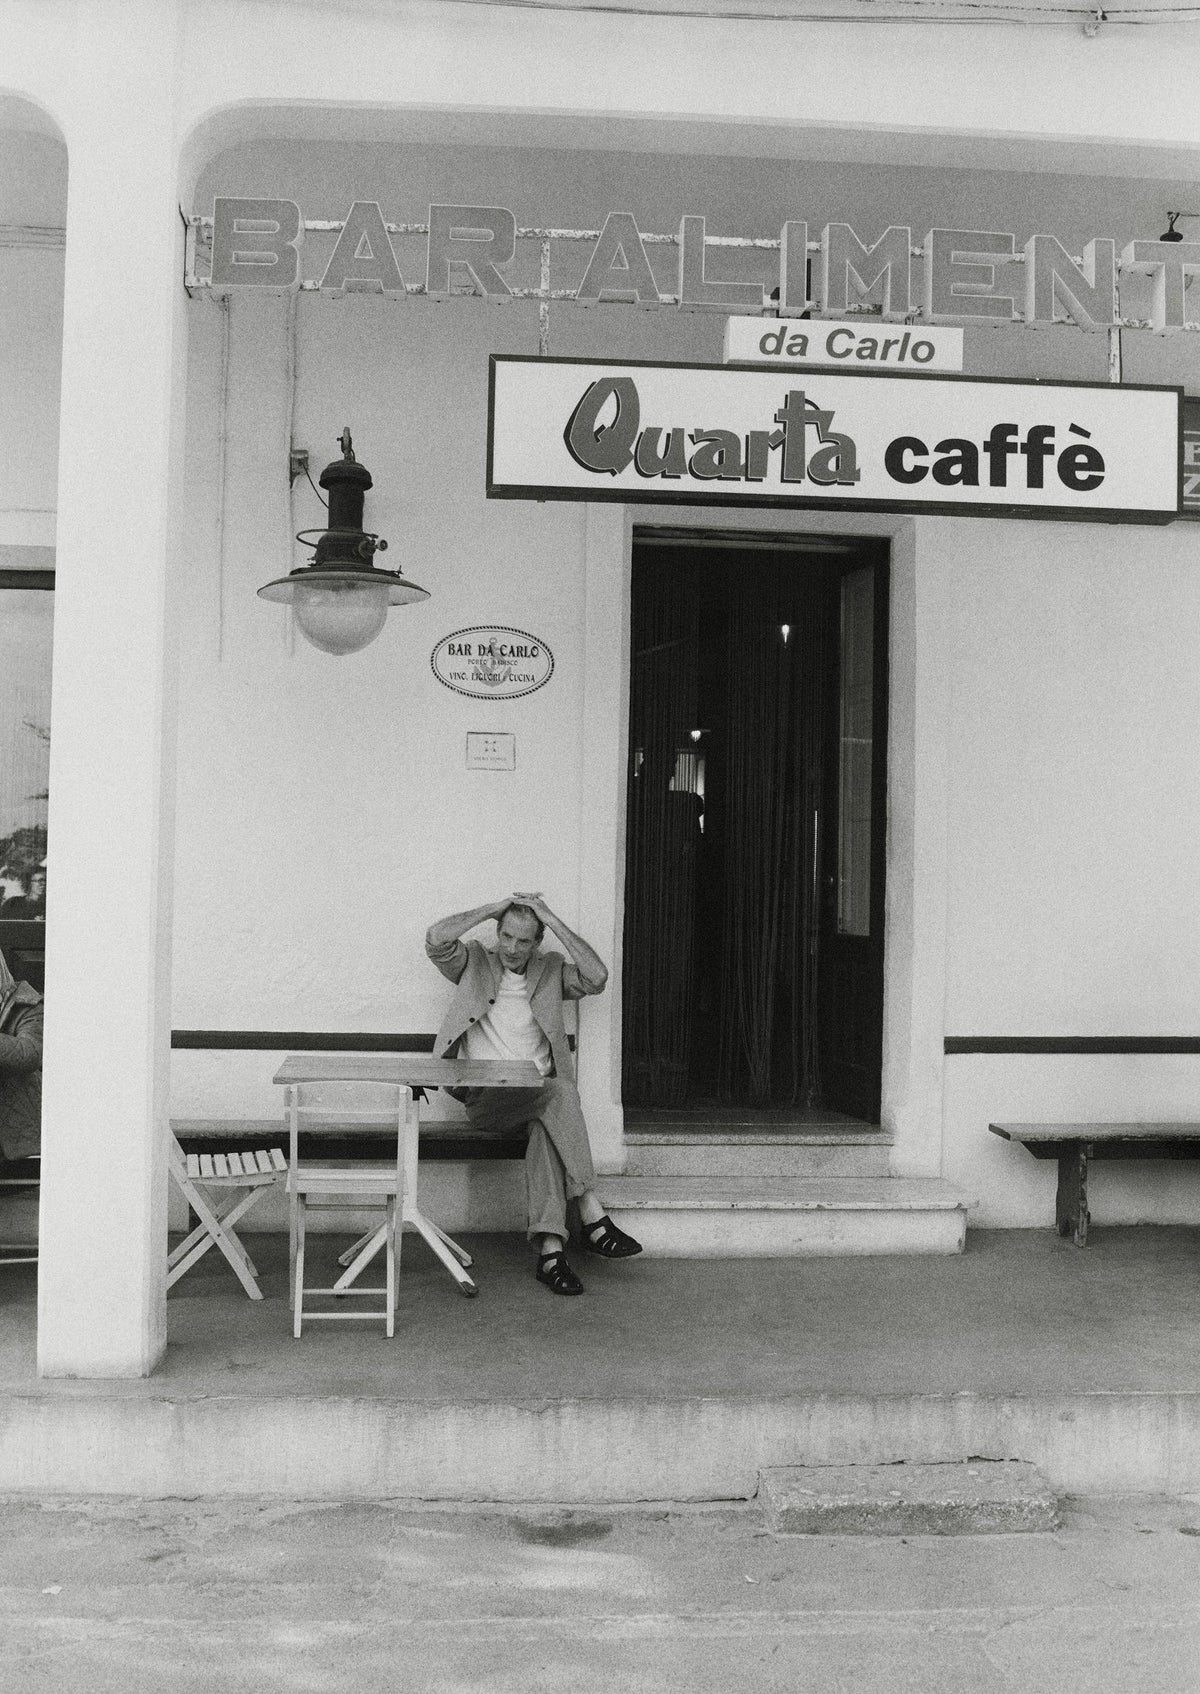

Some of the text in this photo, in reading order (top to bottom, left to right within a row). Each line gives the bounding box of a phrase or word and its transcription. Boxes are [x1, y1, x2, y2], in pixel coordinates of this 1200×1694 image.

[211, 196, 513, 297] BAR
[759, 326, 935, 363] da Carlo
[563, 377, 1105, 491] Quarta caffè
[448, 643, 539, 658] BAR DA CARLO
[508, 674, 535, 683] CUCINA
